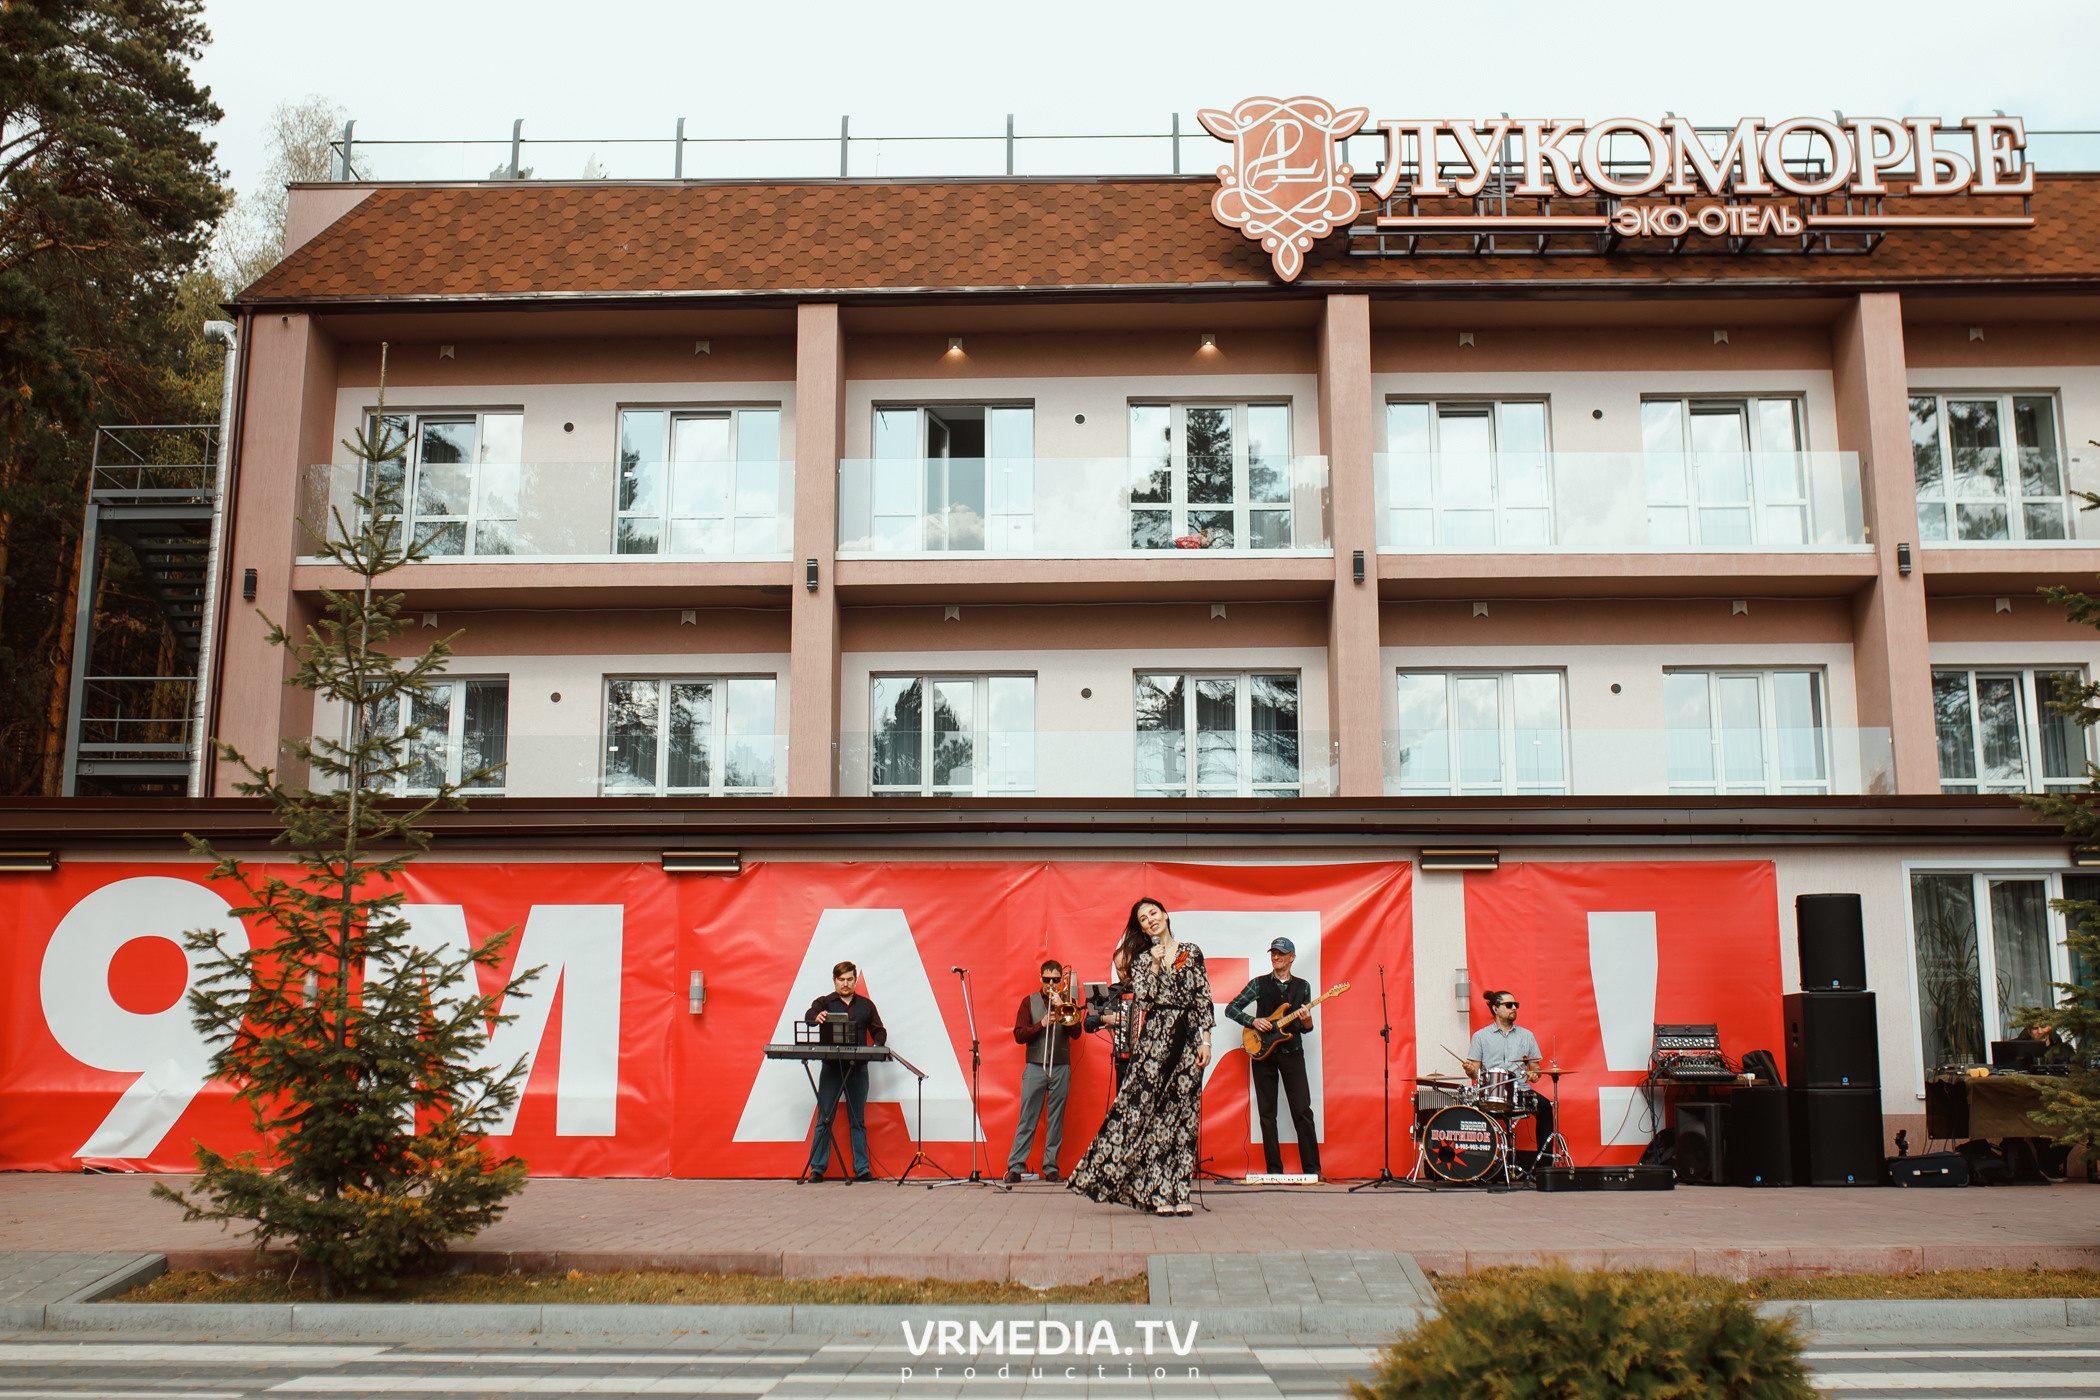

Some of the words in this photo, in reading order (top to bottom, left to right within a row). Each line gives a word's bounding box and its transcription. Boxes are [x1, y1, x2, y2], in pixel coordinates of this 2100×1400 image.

[1370, 116, 2036, 199] ЛУКОМОРЬЕ
[1612, 205, 1803, 236] ЭКО-ОТЕЛЬ
[40, 876, 251, 1159] 9
